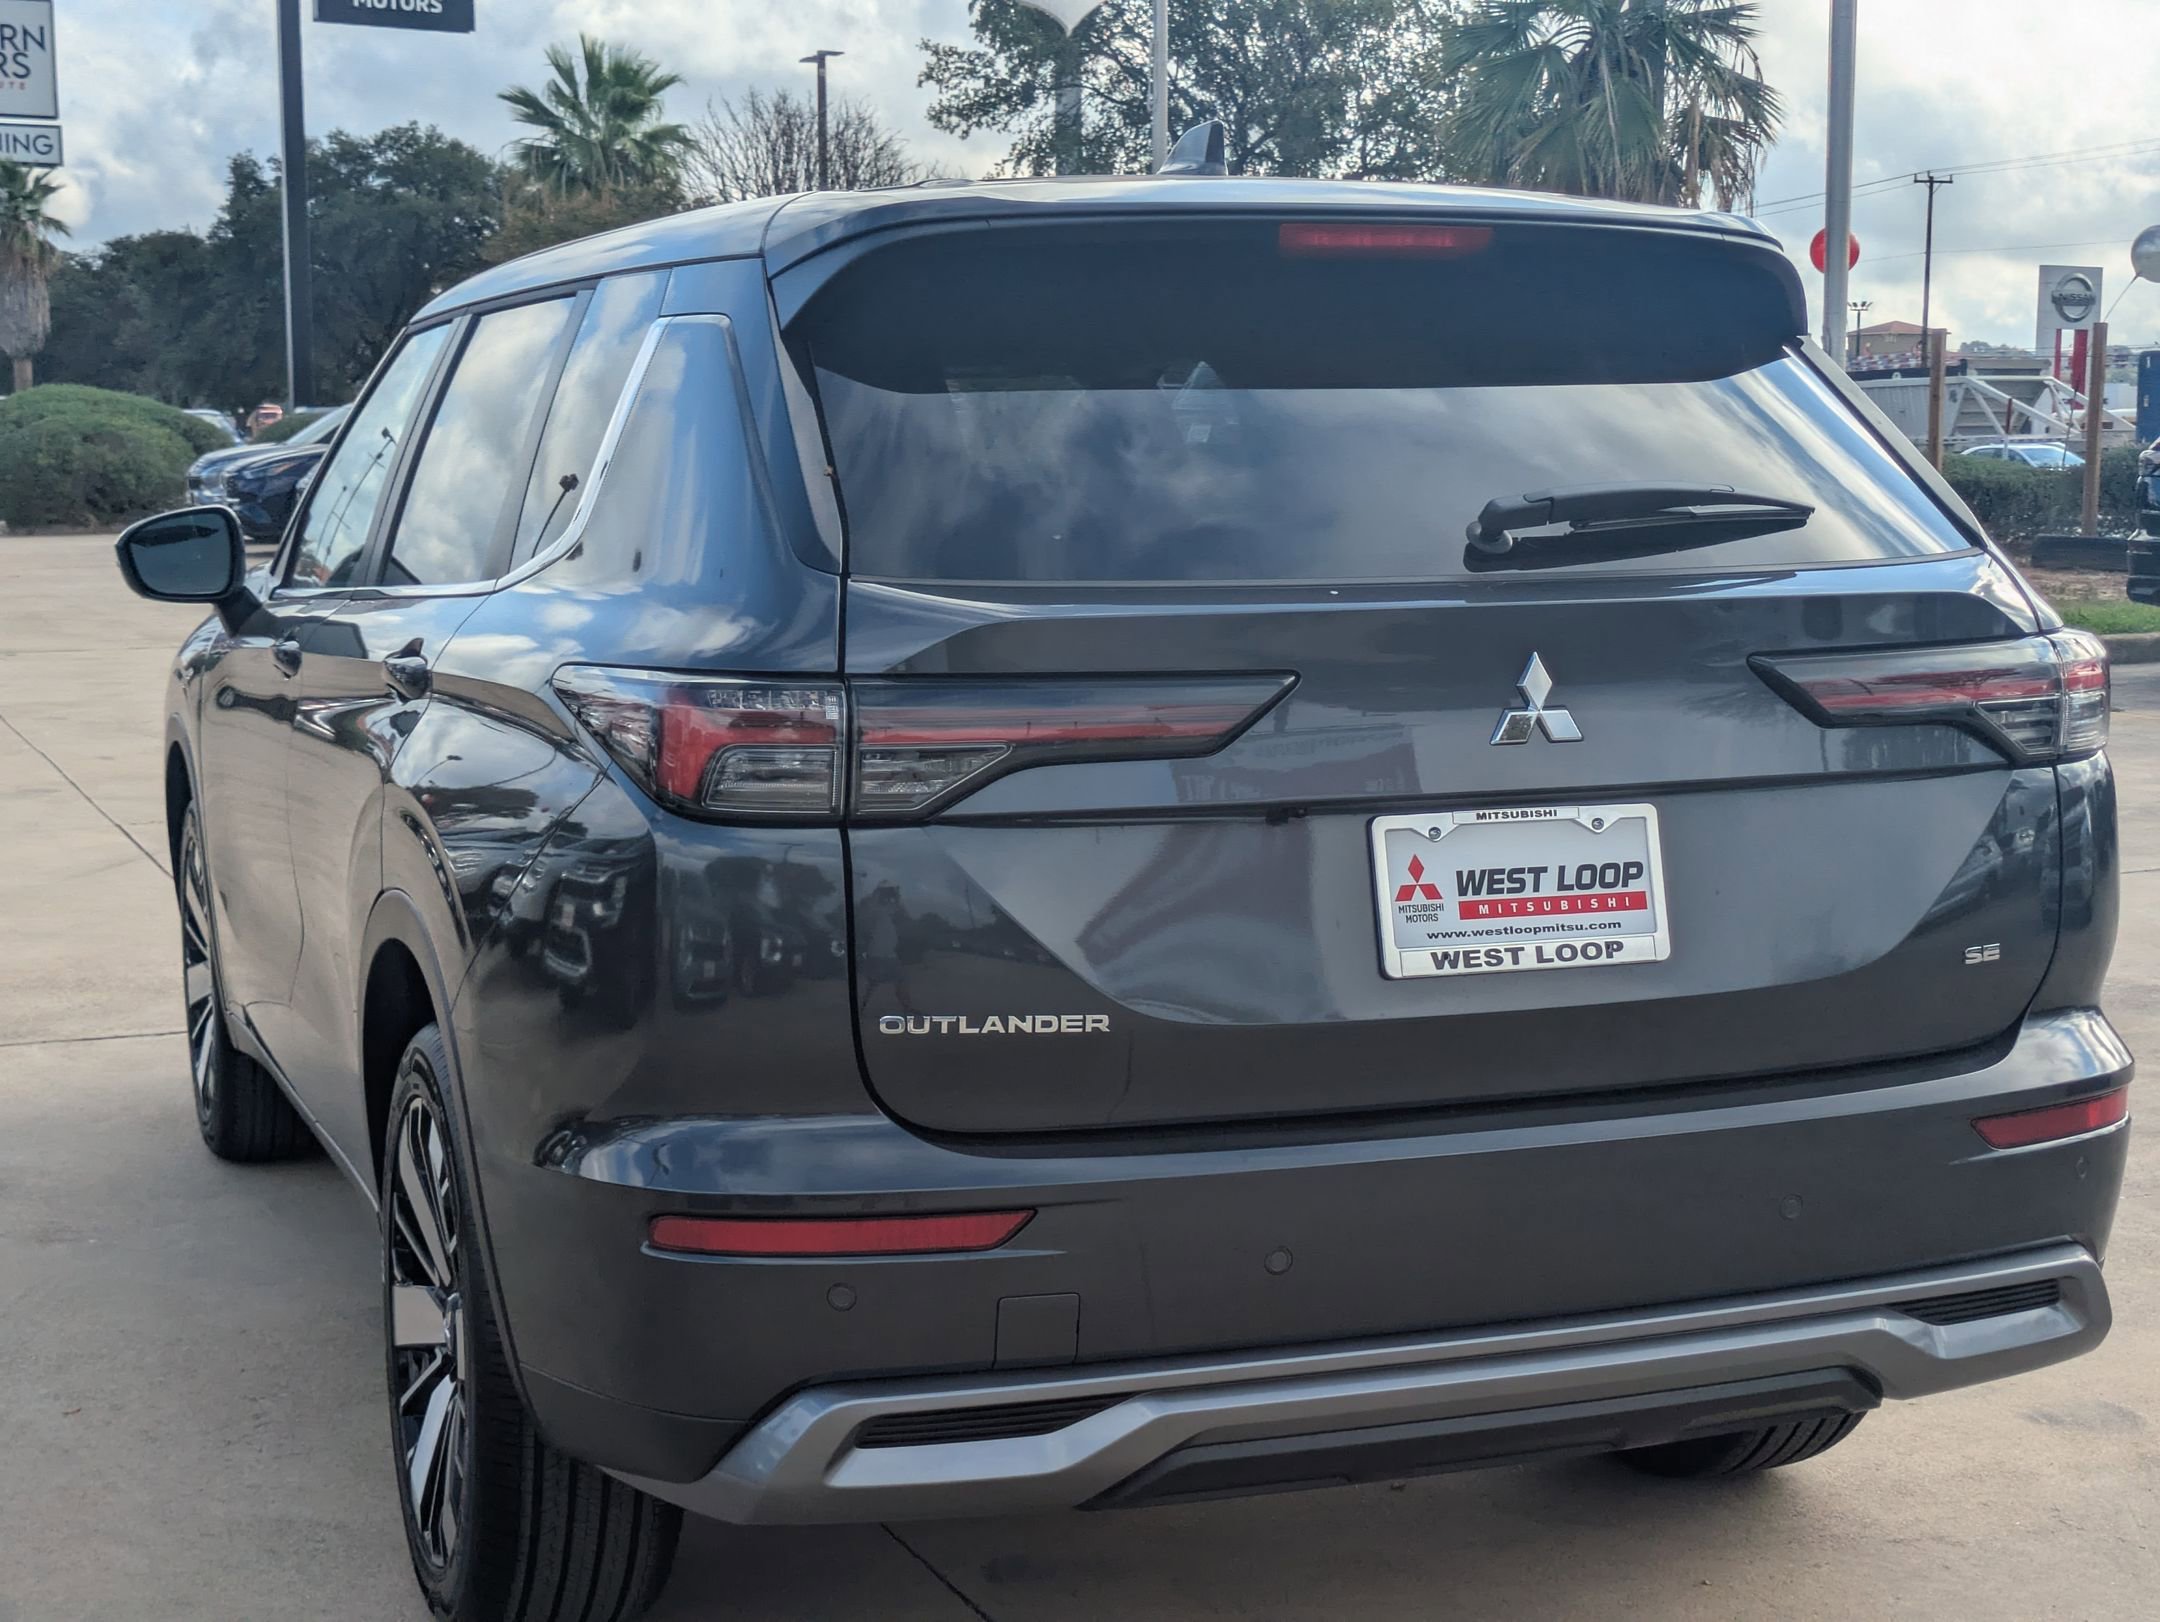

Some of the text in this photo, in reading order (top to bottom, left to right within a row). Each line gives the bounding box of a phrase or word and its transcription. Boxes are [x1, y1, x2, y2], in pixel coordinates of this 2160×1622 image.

[1476, 809, 1558, 821] MITSUBISHI
[1456, 861, 1644, 897] WEST LOOP
[1398, 903, 1444, 914] MITSUBISHI
[1478, 896, 1631, 915] MITSUBISHI
[1405, 914, 1439, 923] MOTORS
[1427, 921, 1622, 940] www.westloopmitsu.com
[1431, 940, 1624, 971] WEST LOOP
[1965, 943, 2000, 964] SE
[879, 1014, 1111, 1035] OUTLANDER
